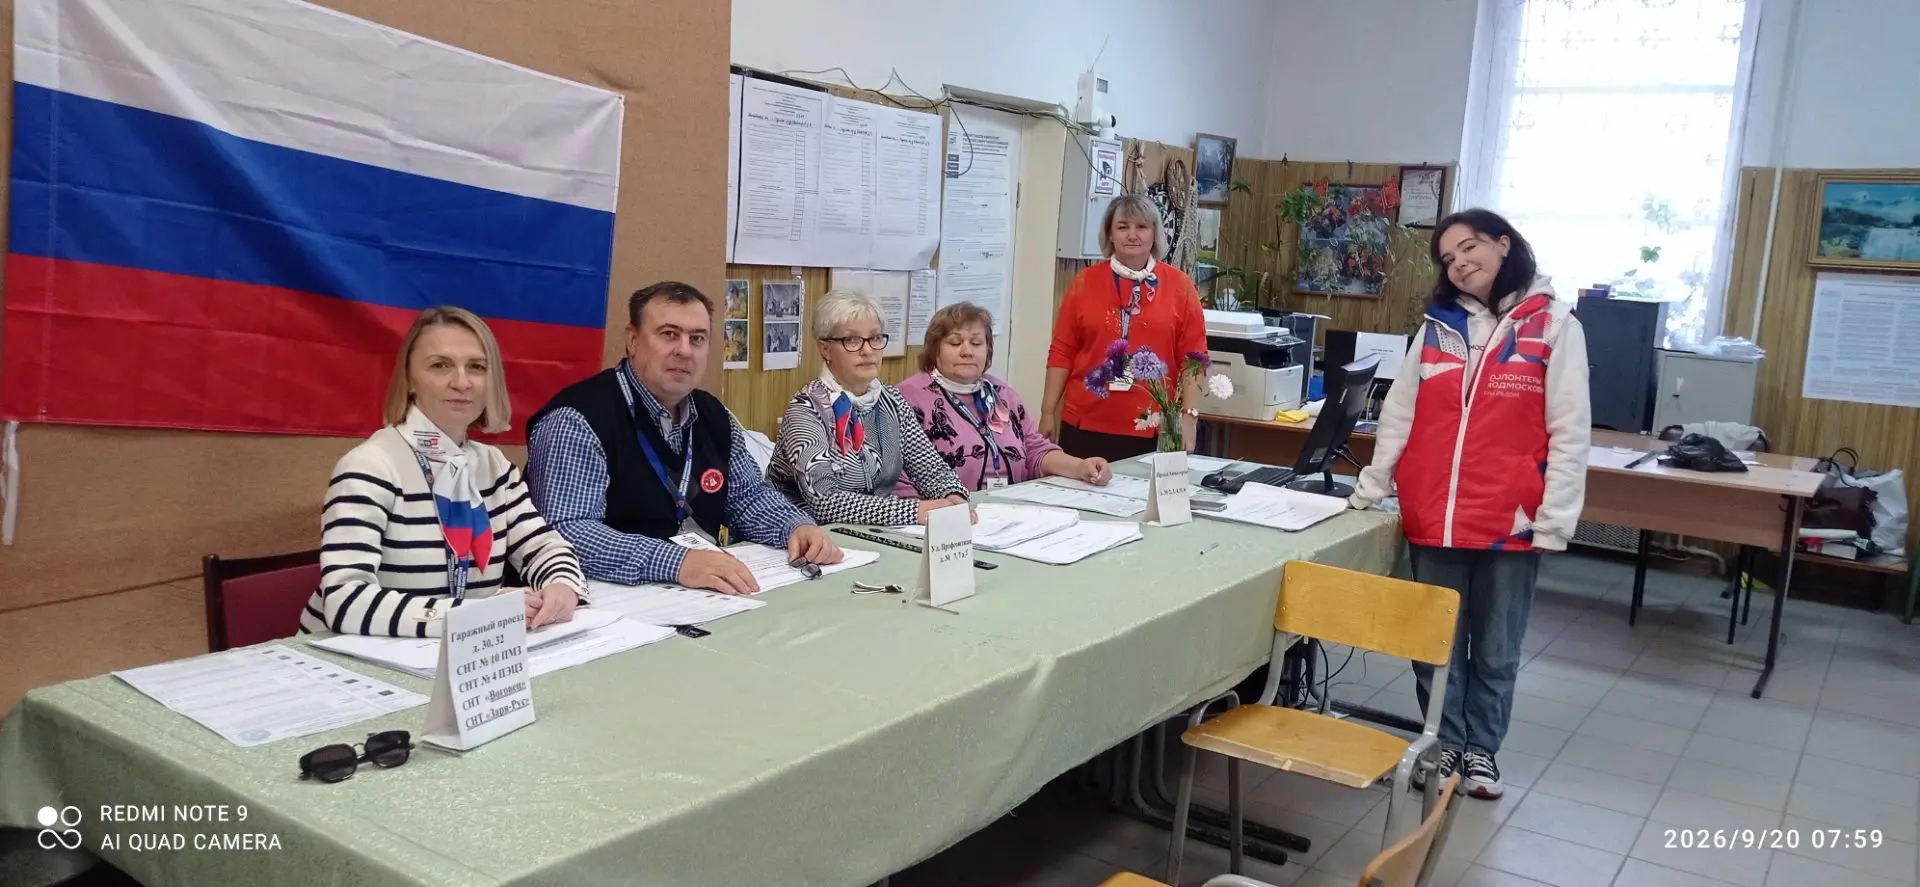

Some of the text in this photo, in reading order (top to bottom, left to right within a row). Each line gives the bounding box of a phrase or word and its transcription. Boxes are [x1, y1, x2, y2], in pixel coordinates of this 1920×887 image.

[451, 621, 496, 642] Гаражный
[495, 634, 505, 645] 32
[456, 645, 522, 676] СНТ № 10 ПМЗ
[458, 662, 524, 693] СНТ № 4 ПЭЦЗ
[462, 695, 481, 711] СНТ
[465, 713, 484, 731] СНТ
